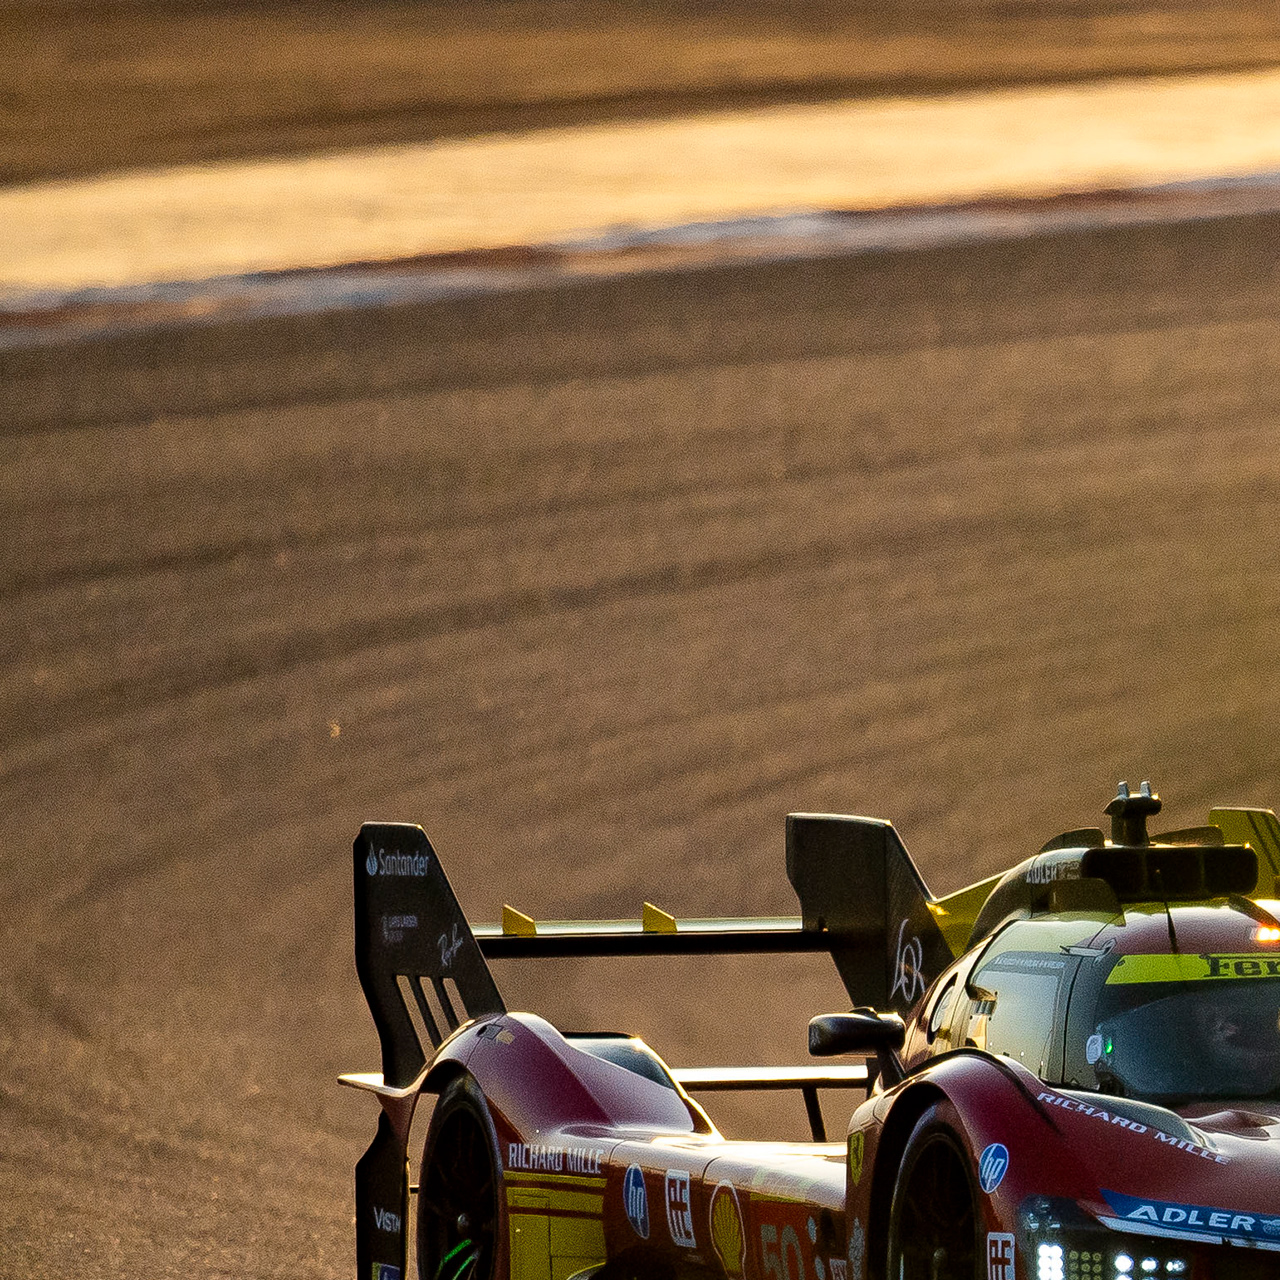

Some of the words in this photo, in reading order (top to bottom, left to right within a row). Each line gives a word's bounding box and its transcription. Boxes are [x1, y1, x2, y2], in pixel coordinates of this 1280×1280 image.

[379, 848, 429, 876] Santander
[1036, 1092, 1149, 1134] RICHARD
[1154, 1131, 1231, 1165] MILLE
[508, 1143, 563, 1171] RICHARD
[566, 1147, 604, 1174] MILLE
[981, 1144, 1006, 1191] hp
[627, 1165, 646, 1238] hp
[1125, 1205, 1256, 1231] ADLER
